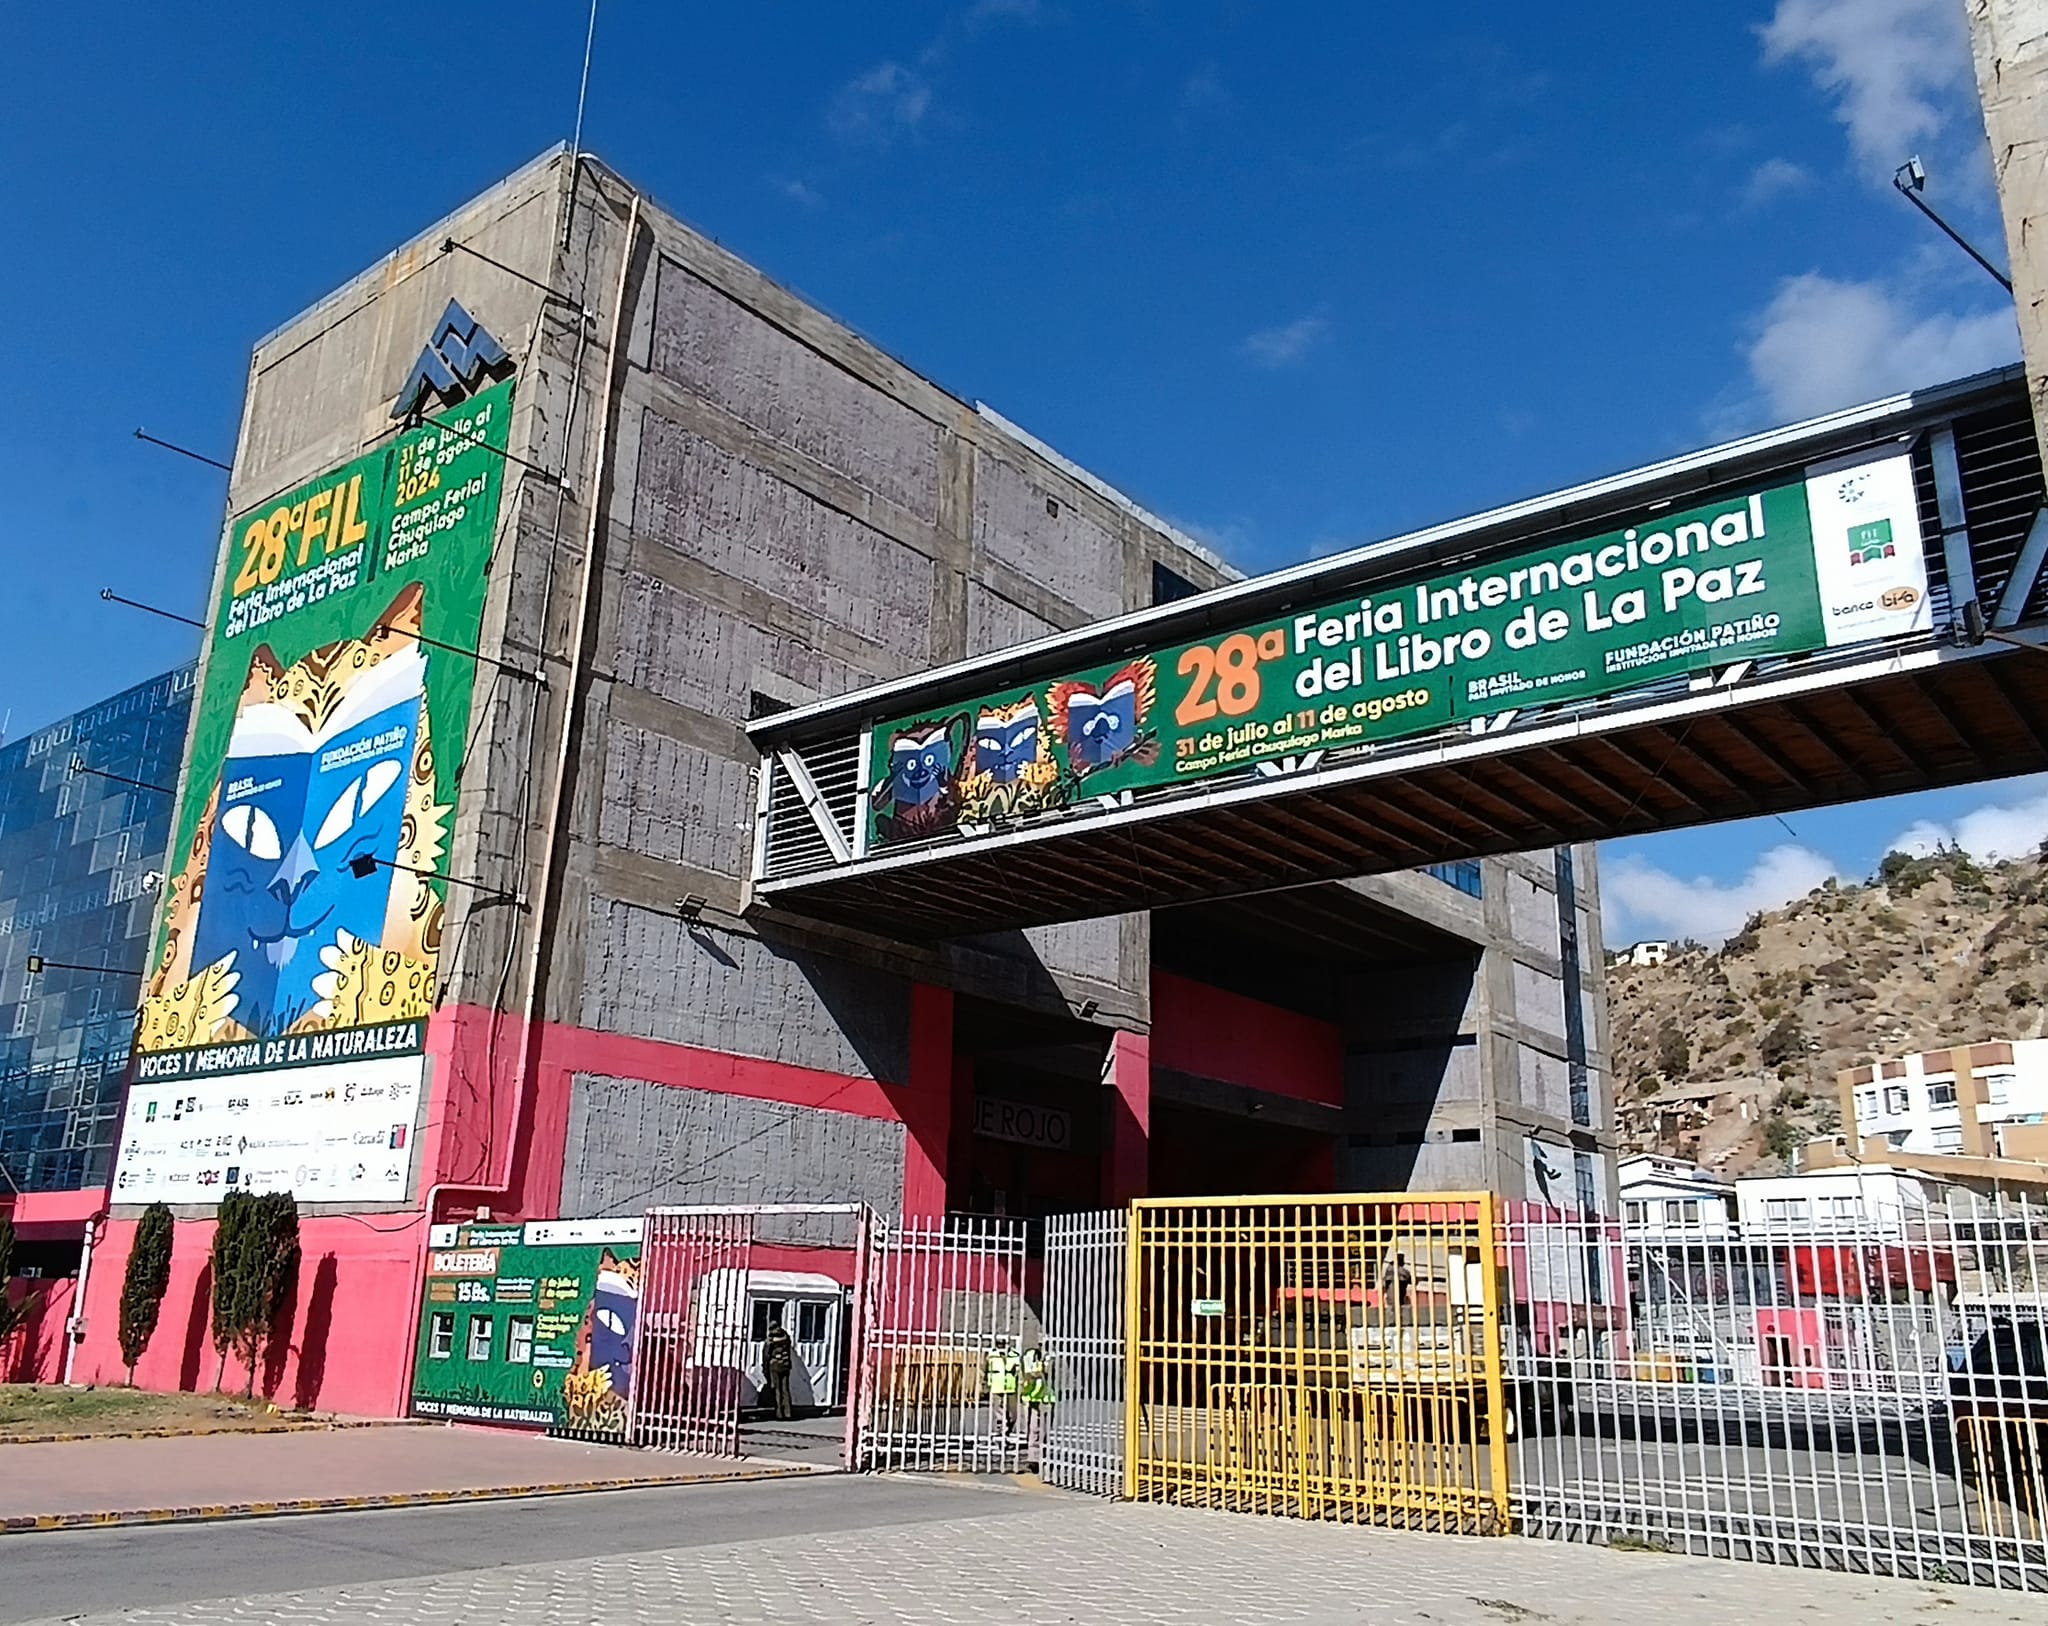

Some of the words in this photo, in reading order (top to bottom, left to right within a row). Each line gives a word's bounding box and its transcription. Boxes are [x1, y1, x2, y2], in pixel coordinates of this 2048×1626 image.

[401, 444, 415, 465] 31
[418, 436, 436, 456] de
[476, 403, 492, 424] al
[395, 466, 441, 507] 2024
[414, 456, 431, 475] de
[391, 500, 440, 532] Campo
[444, 472, 488, 509] Ferial
[388, 506, 465, 552] Chuquiago
[384, 540, 430, 571] Marka
[1294, 599, 1403, 654] Feria
[1416, 493, 1767, 625] Internacional
[225, 609, 250, 638] del
[249, 602, 284, 628] Libro
[286, 591, 306, 612] de
[308, 583, 326, 603] La
[329, 570, 358, 595] Paz
[228, 591, 265, 620] Feria
[265, 542, 365, 603] Internacional
[1295, 646, 1362, 698] del
[1376, 629, 1492, 681] Libro
[1504, 606, 1570, 651] de
[1585, 589, 1647, 632] La
[1662, 559, 1767, 613] Paz
[1832, 601, 1874, 616] banco
[1605, 630, 1706, 665] FUNDACIÓN
[1711, 614, 1780, 640] PATIÑO
[1720, 636, 1735, 647] DE
[1468, 672, 1522, 693] BRASIL
[1175, 737, 1195, 758] 31
[1199, 732, 1224, 753] de
[1226, 720, 1269, 750] julio
[1273, 713, 1292, 736] al
[1297, 709, 1316, 729] 11
[1319, 704, 1348, 725] de
[1352, 688, 1430, 721] agosto
[1175, 755, 1218, 773] Campo
[1219, 745, 1250, 764] Ferial
[1252, 732, 1320, 756] Chuquiago
[1321, 724, 1363, 742] Marka
[139, 1053, 181, 1078] VOCES
[184, 1051, 195, 1073] Y
[196, 1043, 261, 1072] MEMORIA
[264, 1040, 285, 1065] DE
[287, 1037, 308, 1061] LA
[311, 1023, 418, 1060] NATURALEZA
[1001, 1105, 1065, 1144] ROJO
[433, 1249, 497, 1272] BOLETERÍA
